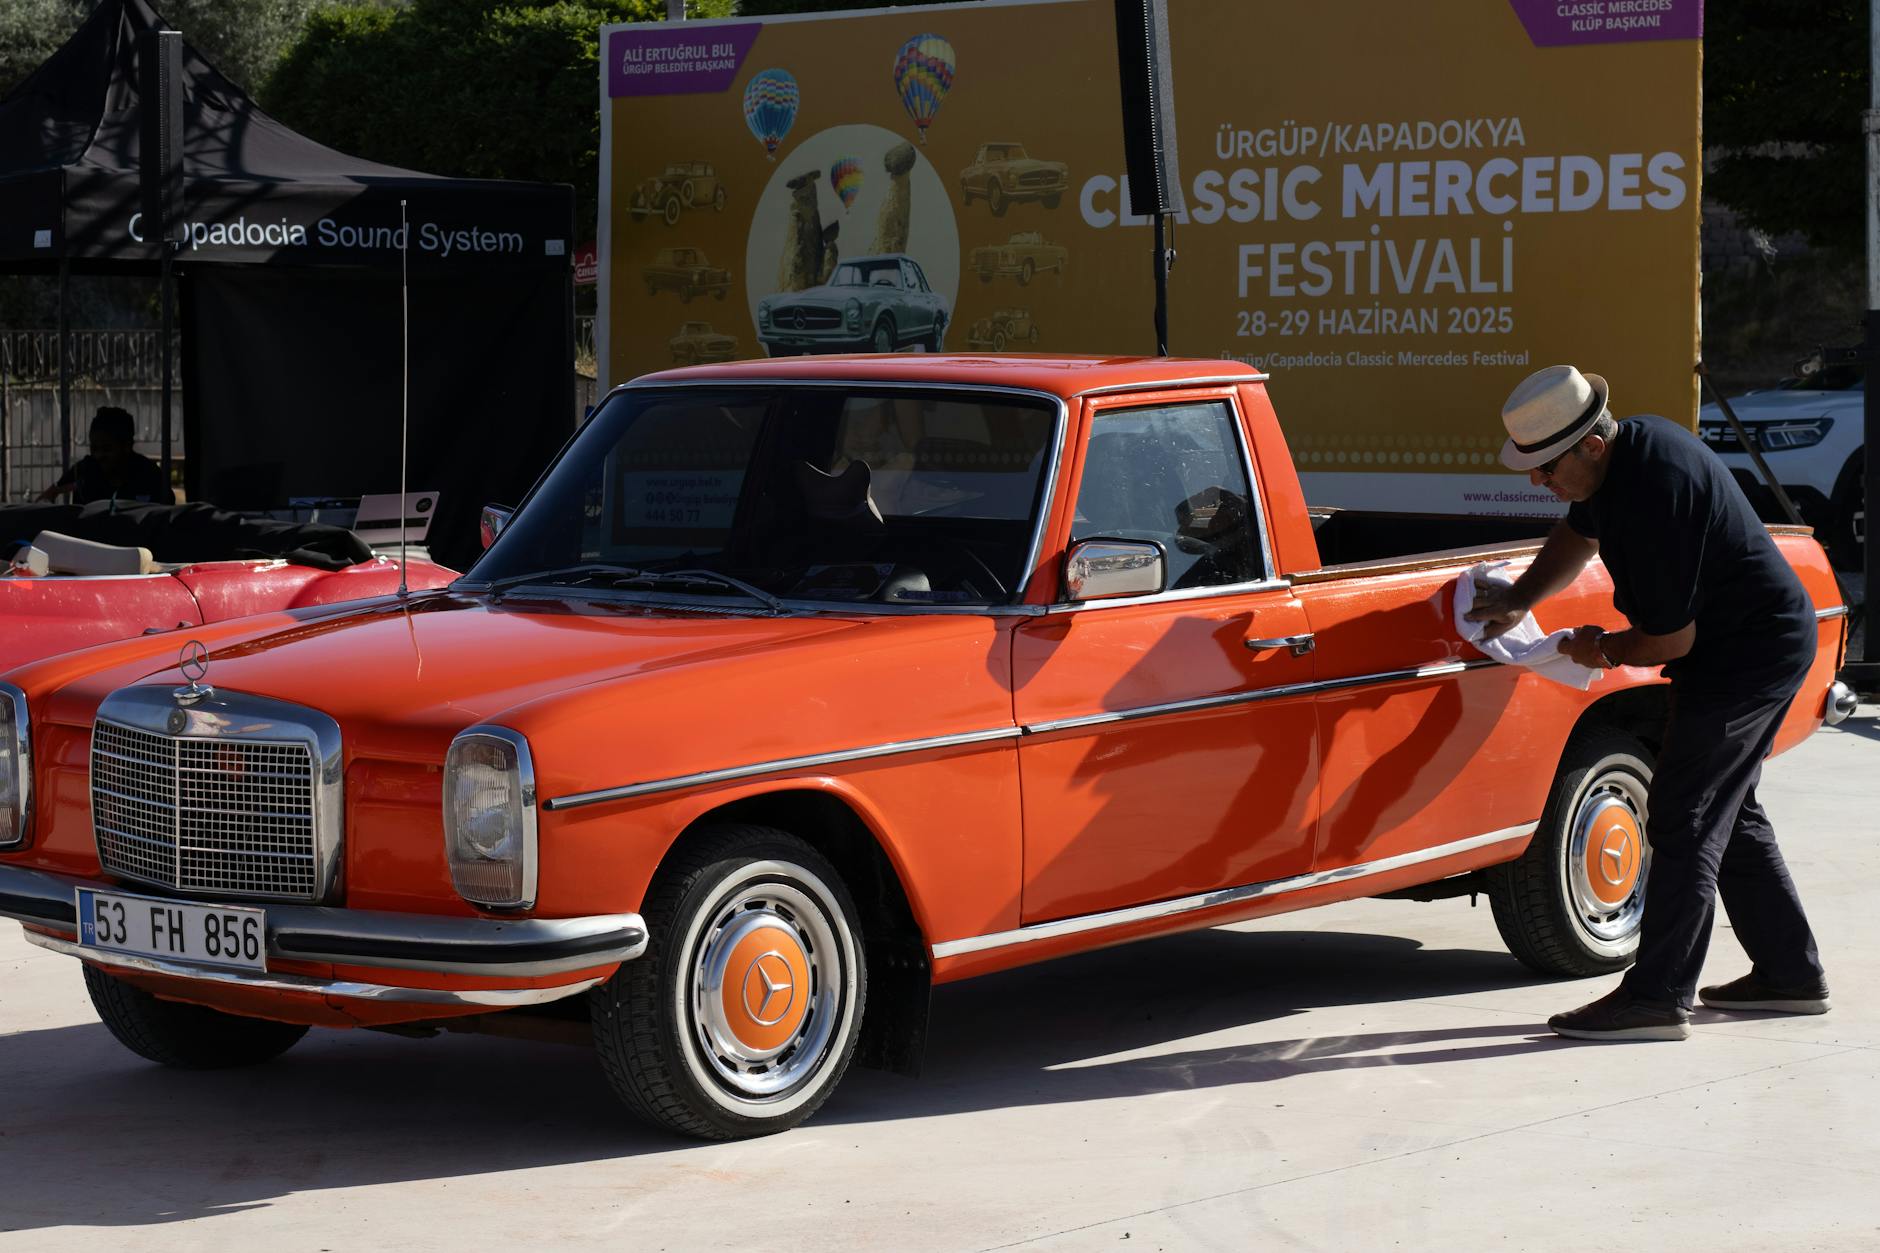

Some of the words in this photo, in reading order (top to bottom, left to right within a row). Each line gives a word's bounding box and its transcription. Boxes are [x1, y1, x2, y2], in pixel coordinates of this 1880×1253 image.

[1608, 0, 1673, 14] MERCEDES
[1571, 16, 1602, 32] KLÜP
[1605, 15, 1660, 32] BAŞKANI
[623, 45, 643, 62] ALİ
[646, 44, 708, 61] ERTUĞRUL
[712, 43, 736, 57] BUL
[623, 60, 653, 75] ÜRGÜP
[655, 61, 694, 73] BELEDİYE
[696, 59, 735, 73] BAŞKANI
[1215, 117, 1526, 160] ÜRGÜP/KAPADOKYA
[1079, 164, 1323, 229] CLSSIC
[1342, 151, 1687, 219] MERCEDES
[128, 212, 307, 251] Cpadocia
[317, 218, 410, 250] Sound
[419, 222, 523, 258] System
[1238, 221, 1514, 298] FESTİVALİ
[1236, 309, 1310, 337] 28-29
[1318, 301, 1438, 335] HAZİRAN
[1447, 306, 1514, 334] 2025
[1346, 351, 1394, 367] Classic
[1398, 350, 1468, 367] Mercedes
[1473, 349, 1530, 366] Festival
[83, 921, 94, 935] TR
[96, 900, 127, 944] 53
[150, 907, 185, 952] FH
[204, 913, 259, 960] 856
